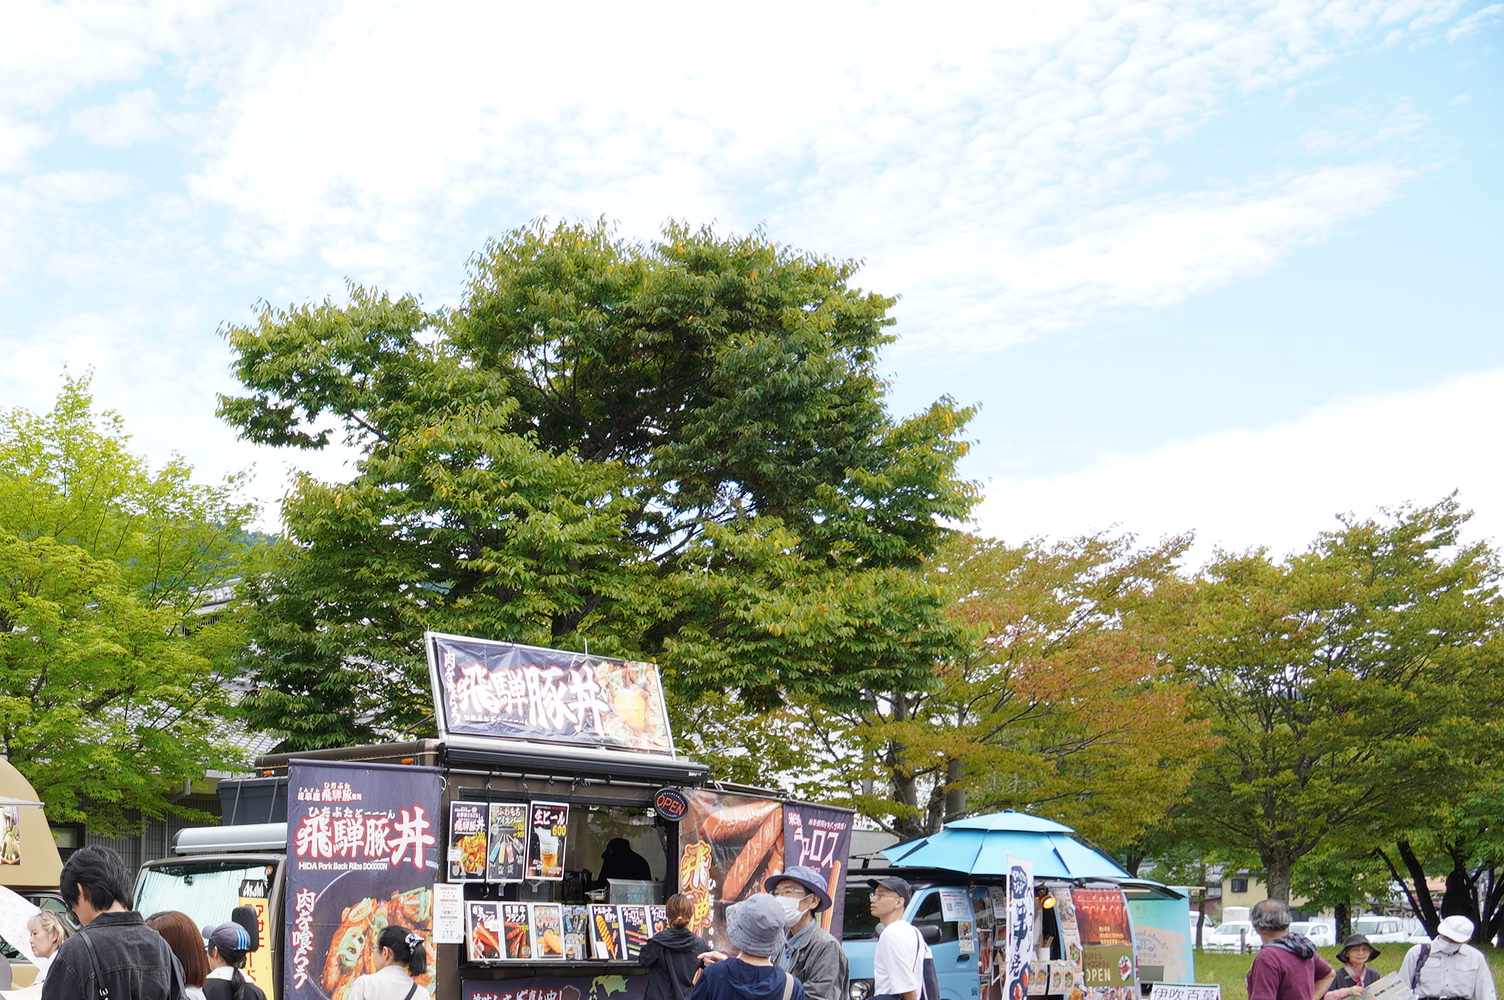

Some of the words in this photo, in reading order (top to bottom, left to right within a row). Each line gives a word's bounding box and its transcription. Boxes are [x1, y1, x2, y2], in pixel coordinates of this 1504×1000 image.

[456, 664, 610, 736] 飛騨豚丼
[656, 795, 686, 815] OPEN
[533, 809, 566, 826] 生ビール
[296, 806, 436, 869] 飛騨豚丼
[552, 825, 567, 837] 600
[298, 861, 318, 870] HIDA
[318, 862, 333, 870] Pork
[333, 862, 348, 870] Back
[349, 862, 363, 870] Ribs
[242, 881, 264, 898] Asahi
[506, 914, 525, 923] フランク
[292, 888, 316, 989] 肉を喰らう
